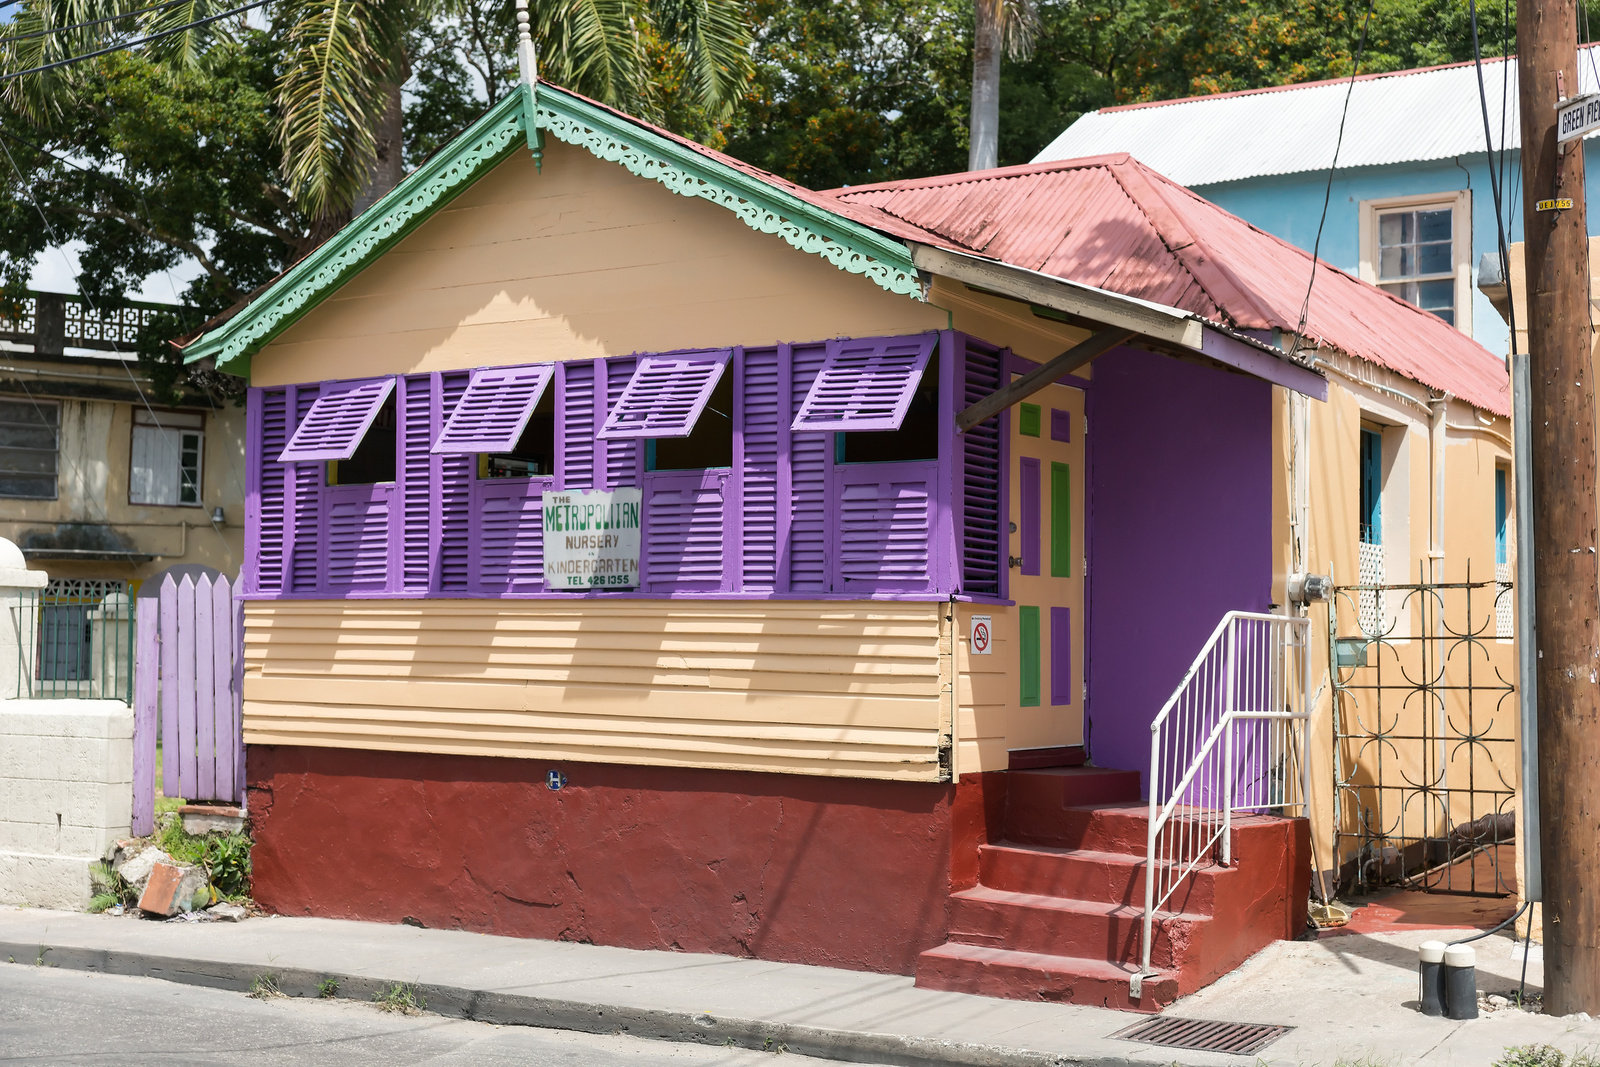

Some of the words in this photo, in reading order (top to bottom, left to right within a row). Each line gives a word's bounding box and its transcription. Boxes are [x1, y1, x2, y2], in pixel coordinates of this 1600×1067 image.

[1562, 105, 1585, 135] GREEN
[552, 496, 571, 504] THE
[545, 501, 639, 532] METROPOLITAN
[565, 535, 619, 550] NURSERY
[547, 558, 639, 574] KINDERGARTEN
[567, 576, 584, 585] TEL
